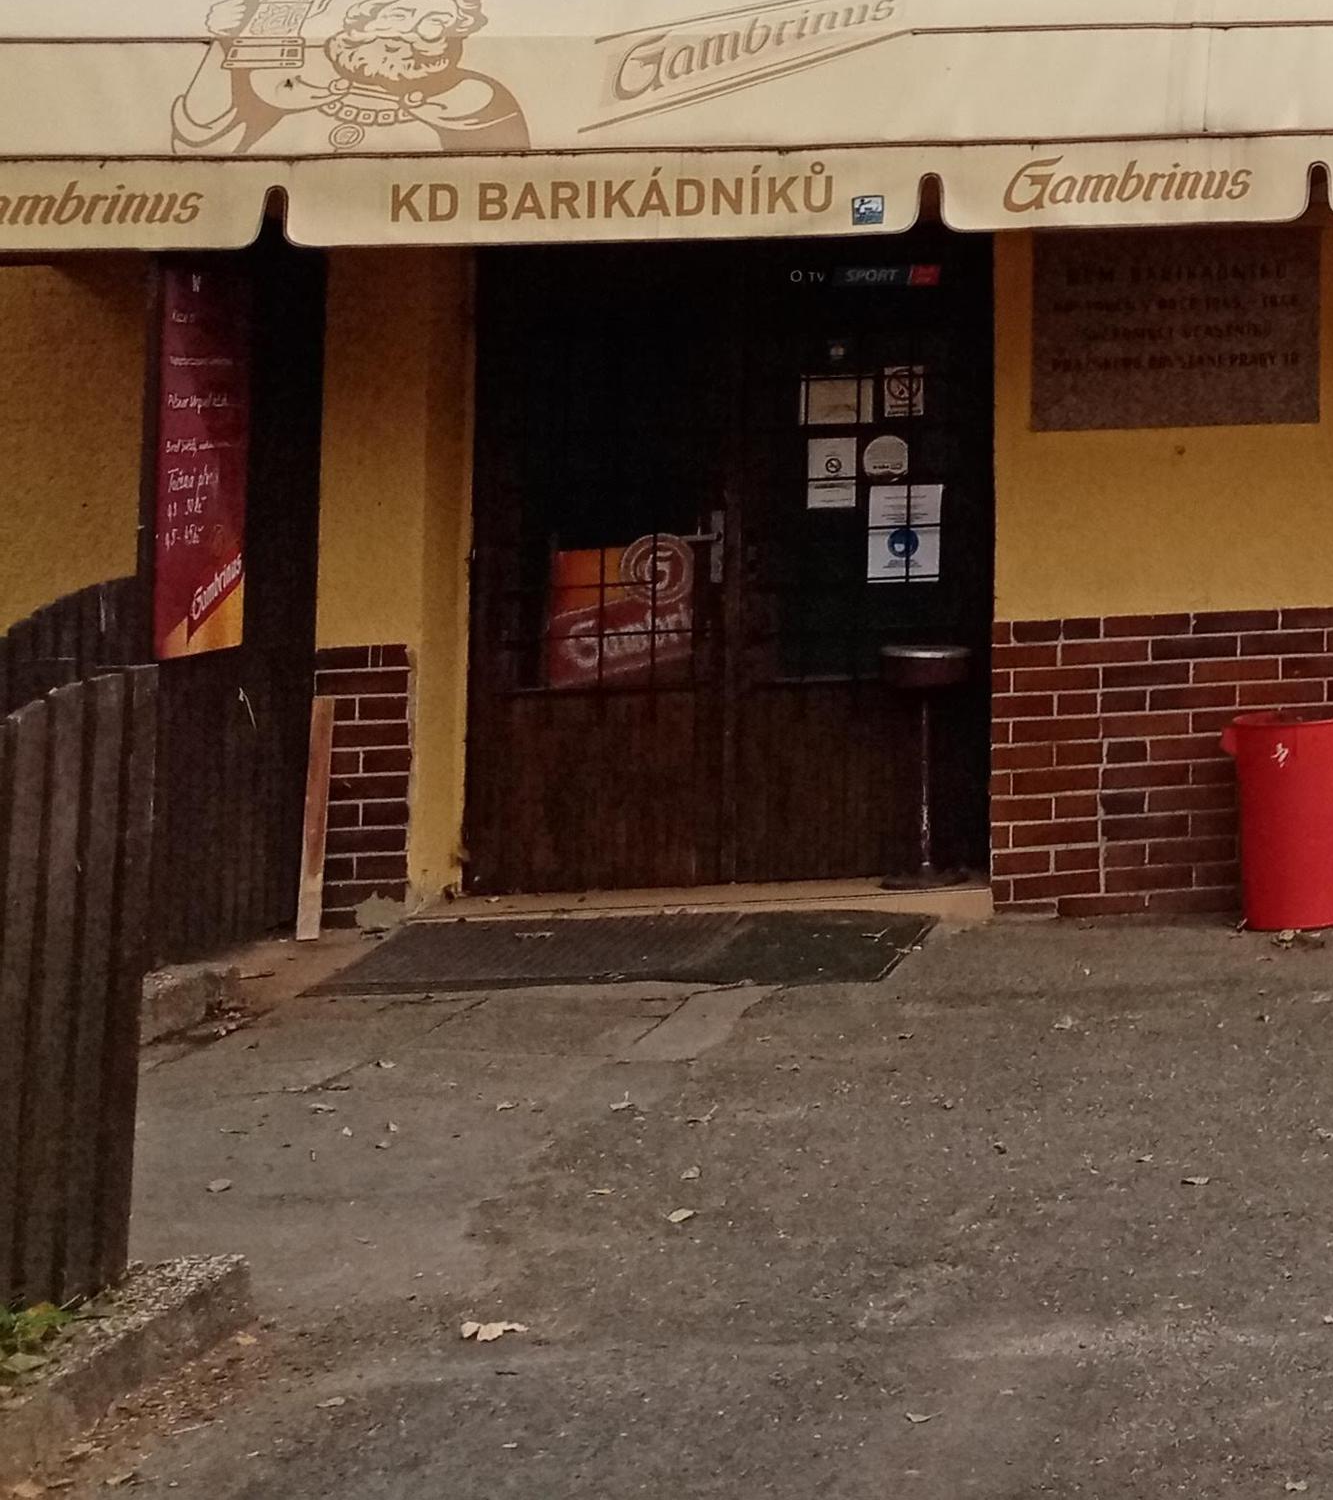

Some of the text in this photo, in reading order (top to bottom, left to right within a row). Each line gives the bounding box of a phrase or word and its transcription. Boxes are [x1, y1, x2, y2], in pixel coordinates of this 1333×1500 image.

[611, 0, 895, 101] Gambrinus
[391, 161, 833, 223] KD BARIKÁDNÍKŮ
[1002, 155, 1253, 214] Gambrinus
[808, 271, 826, 283] TV
[845, 268, 900, 283] SPORT
